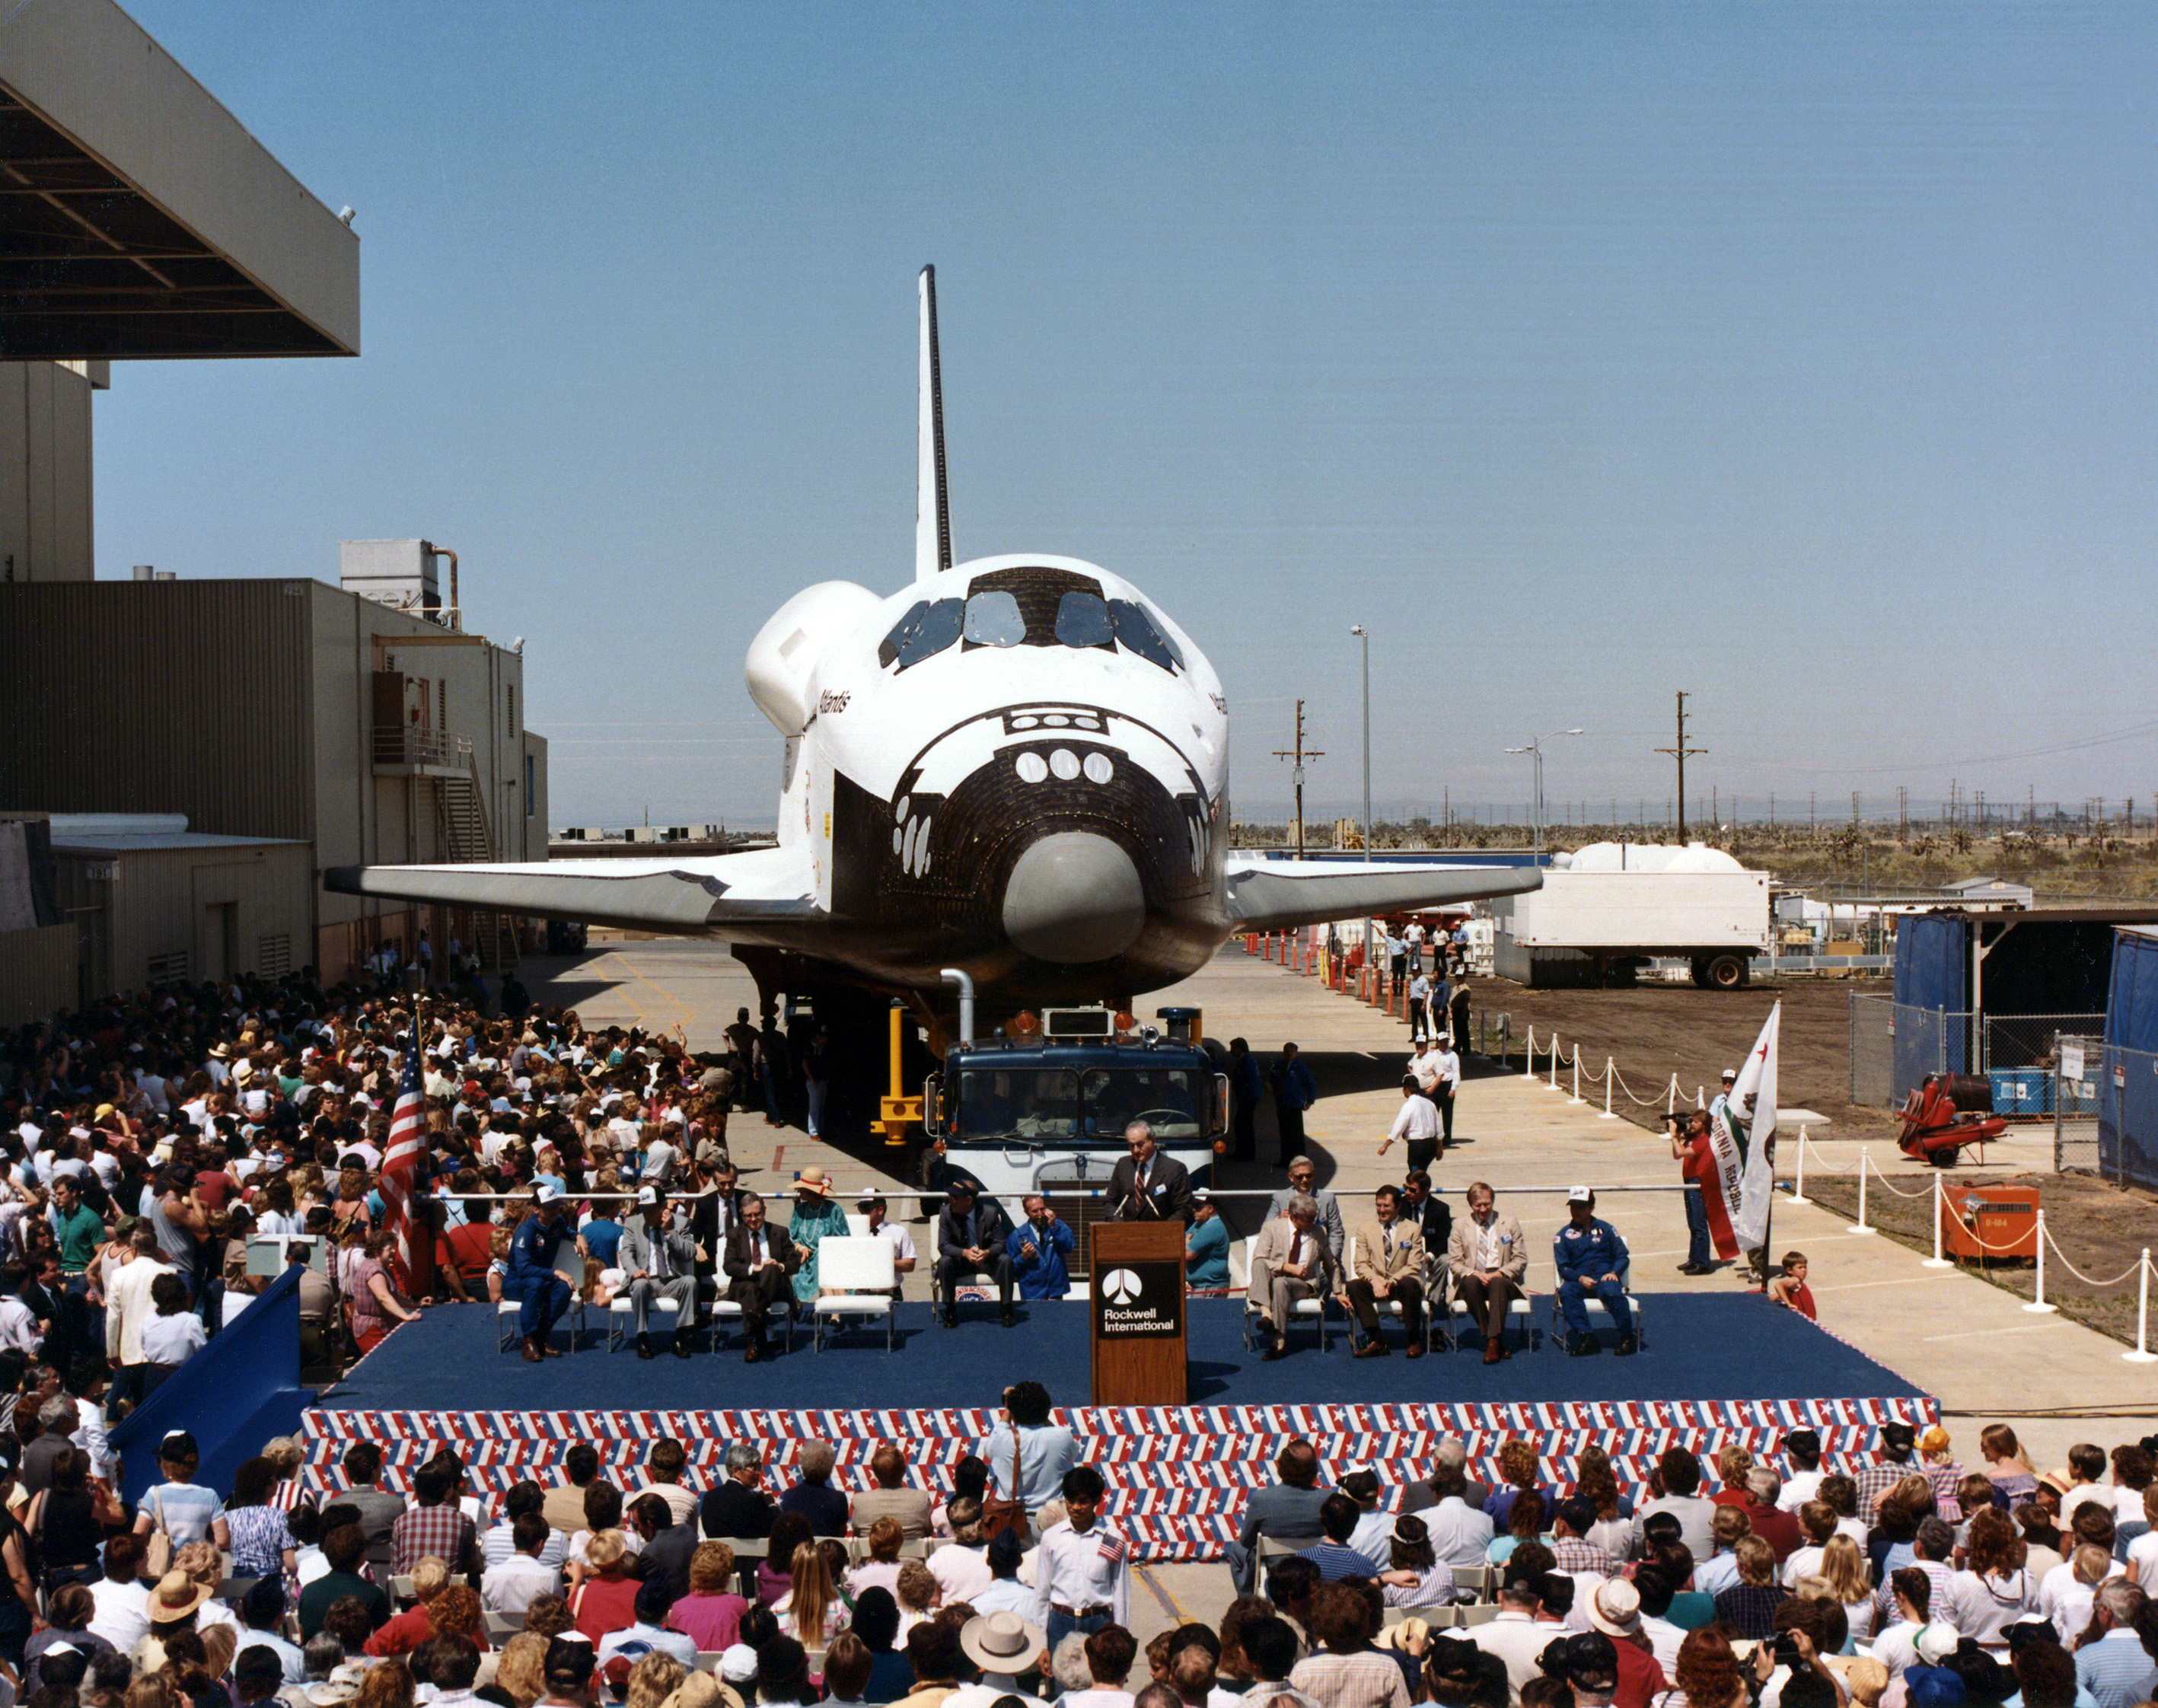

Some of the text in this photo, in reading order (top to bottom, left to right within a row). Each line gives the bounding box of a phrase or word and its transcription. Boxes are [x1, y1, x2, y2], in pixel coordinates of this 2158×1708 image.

[820, 689, 850, 714] Atlantis
[1105, 1308, 1156, 1320] Rockwell
[1105, 1319, 1174, 1331] International
